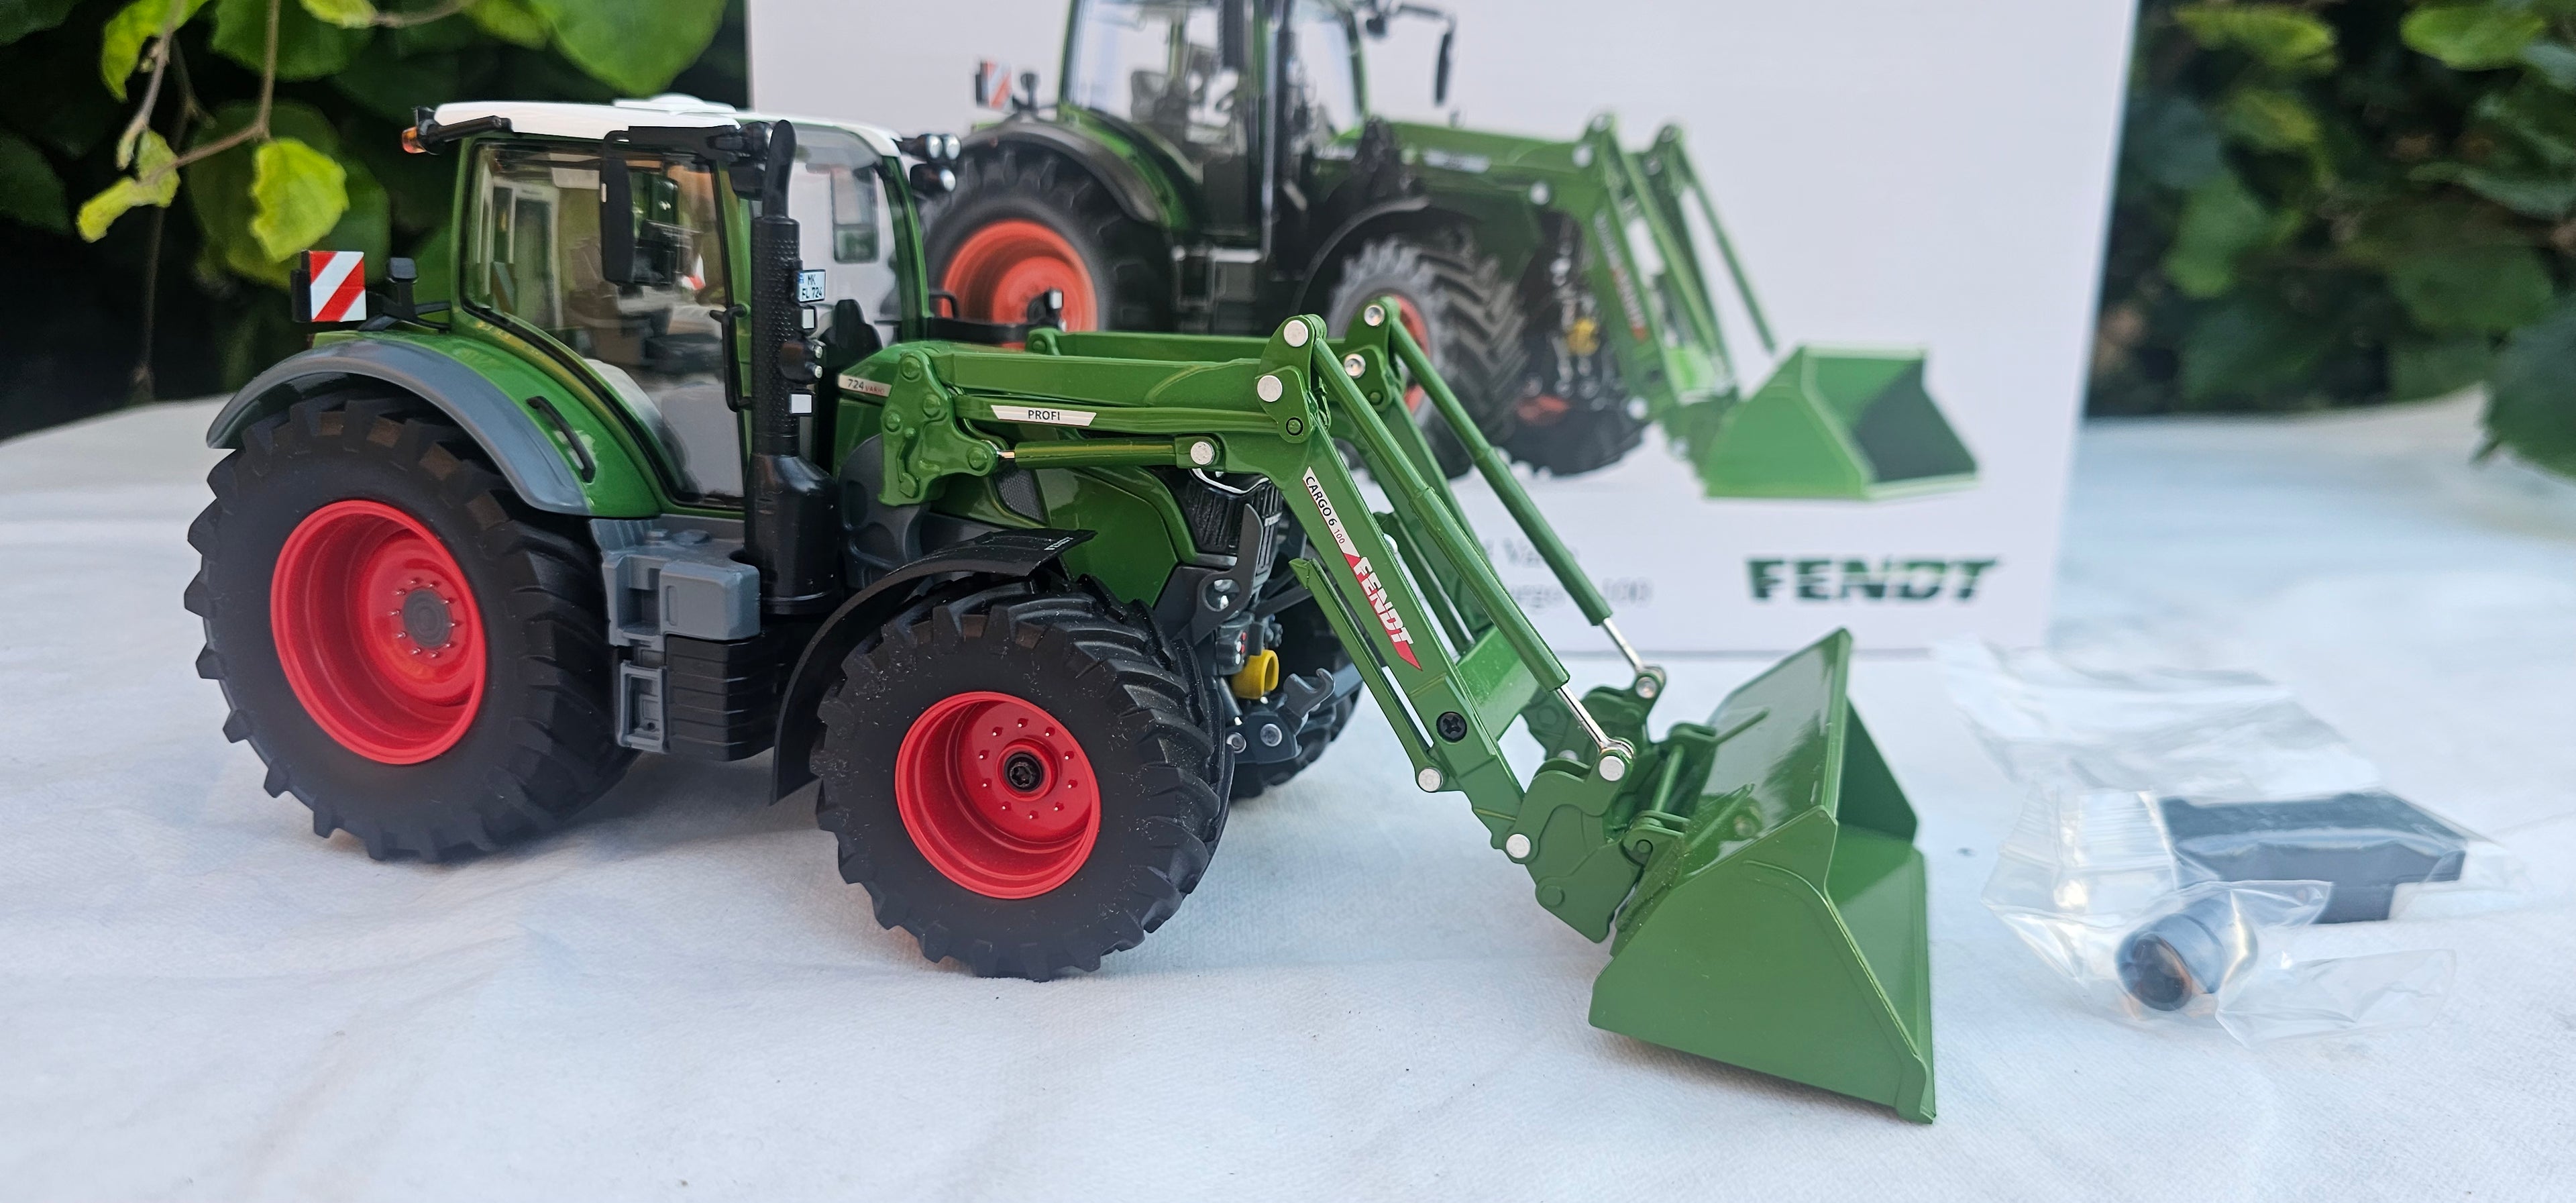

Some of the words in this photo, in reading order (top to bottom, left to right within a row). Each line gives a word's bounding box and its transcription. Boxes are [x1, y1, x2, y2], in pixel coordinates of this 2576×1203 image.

[807, 274, 816, 286] MK
[812, 286, 822, 298] 724
[848, 378, 864, 390] 724
[1028, 410, 1060, 421] PROFI
[1305, 476, 1332, 517] CARGO
[1328, 518, 1338, 526] 6
[1334, 529, 1346, 544] 100
[1747, 558, 1998, 600] FENDT
[1353, 556, 1413, 645] FENDT
